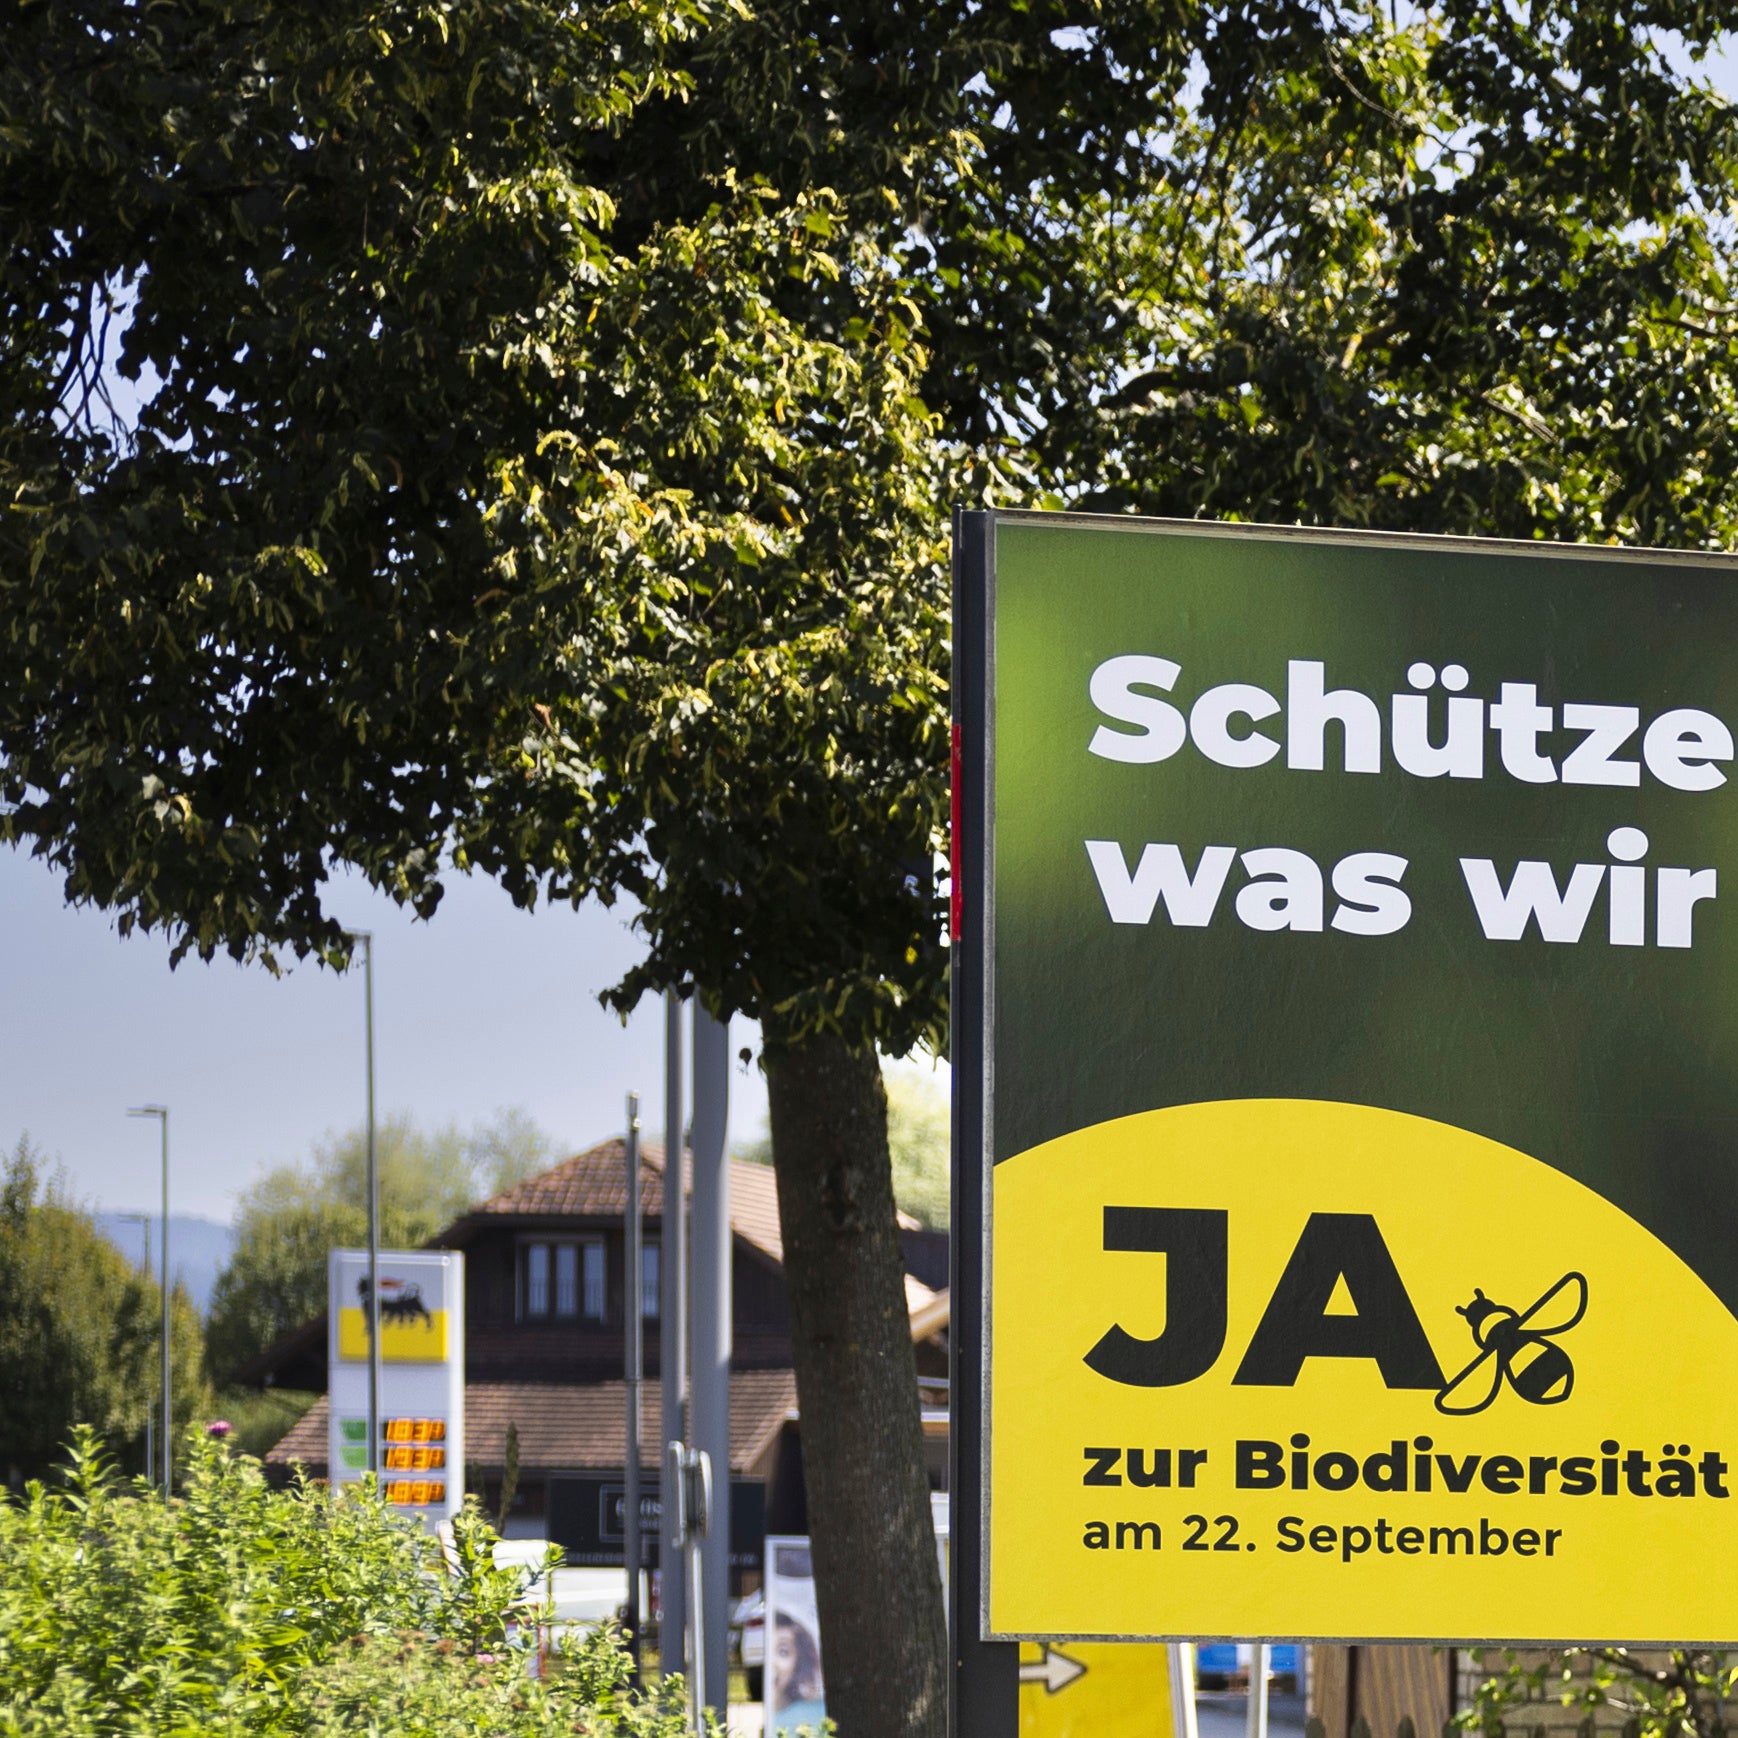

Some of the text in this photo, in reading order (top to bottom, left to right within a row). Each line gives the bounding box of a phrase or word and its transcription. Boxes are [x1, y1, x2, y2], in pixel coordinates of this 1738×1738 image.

[1084, 840, 1412, 936] was
[1459, 826, 1718, 949] wir
[1082, 1205, 1444, 1391] JA
[1083, 1432, 1730, 1499] zur Biodiversität
[1083, 1514, 1562, 1563] am 22. September
